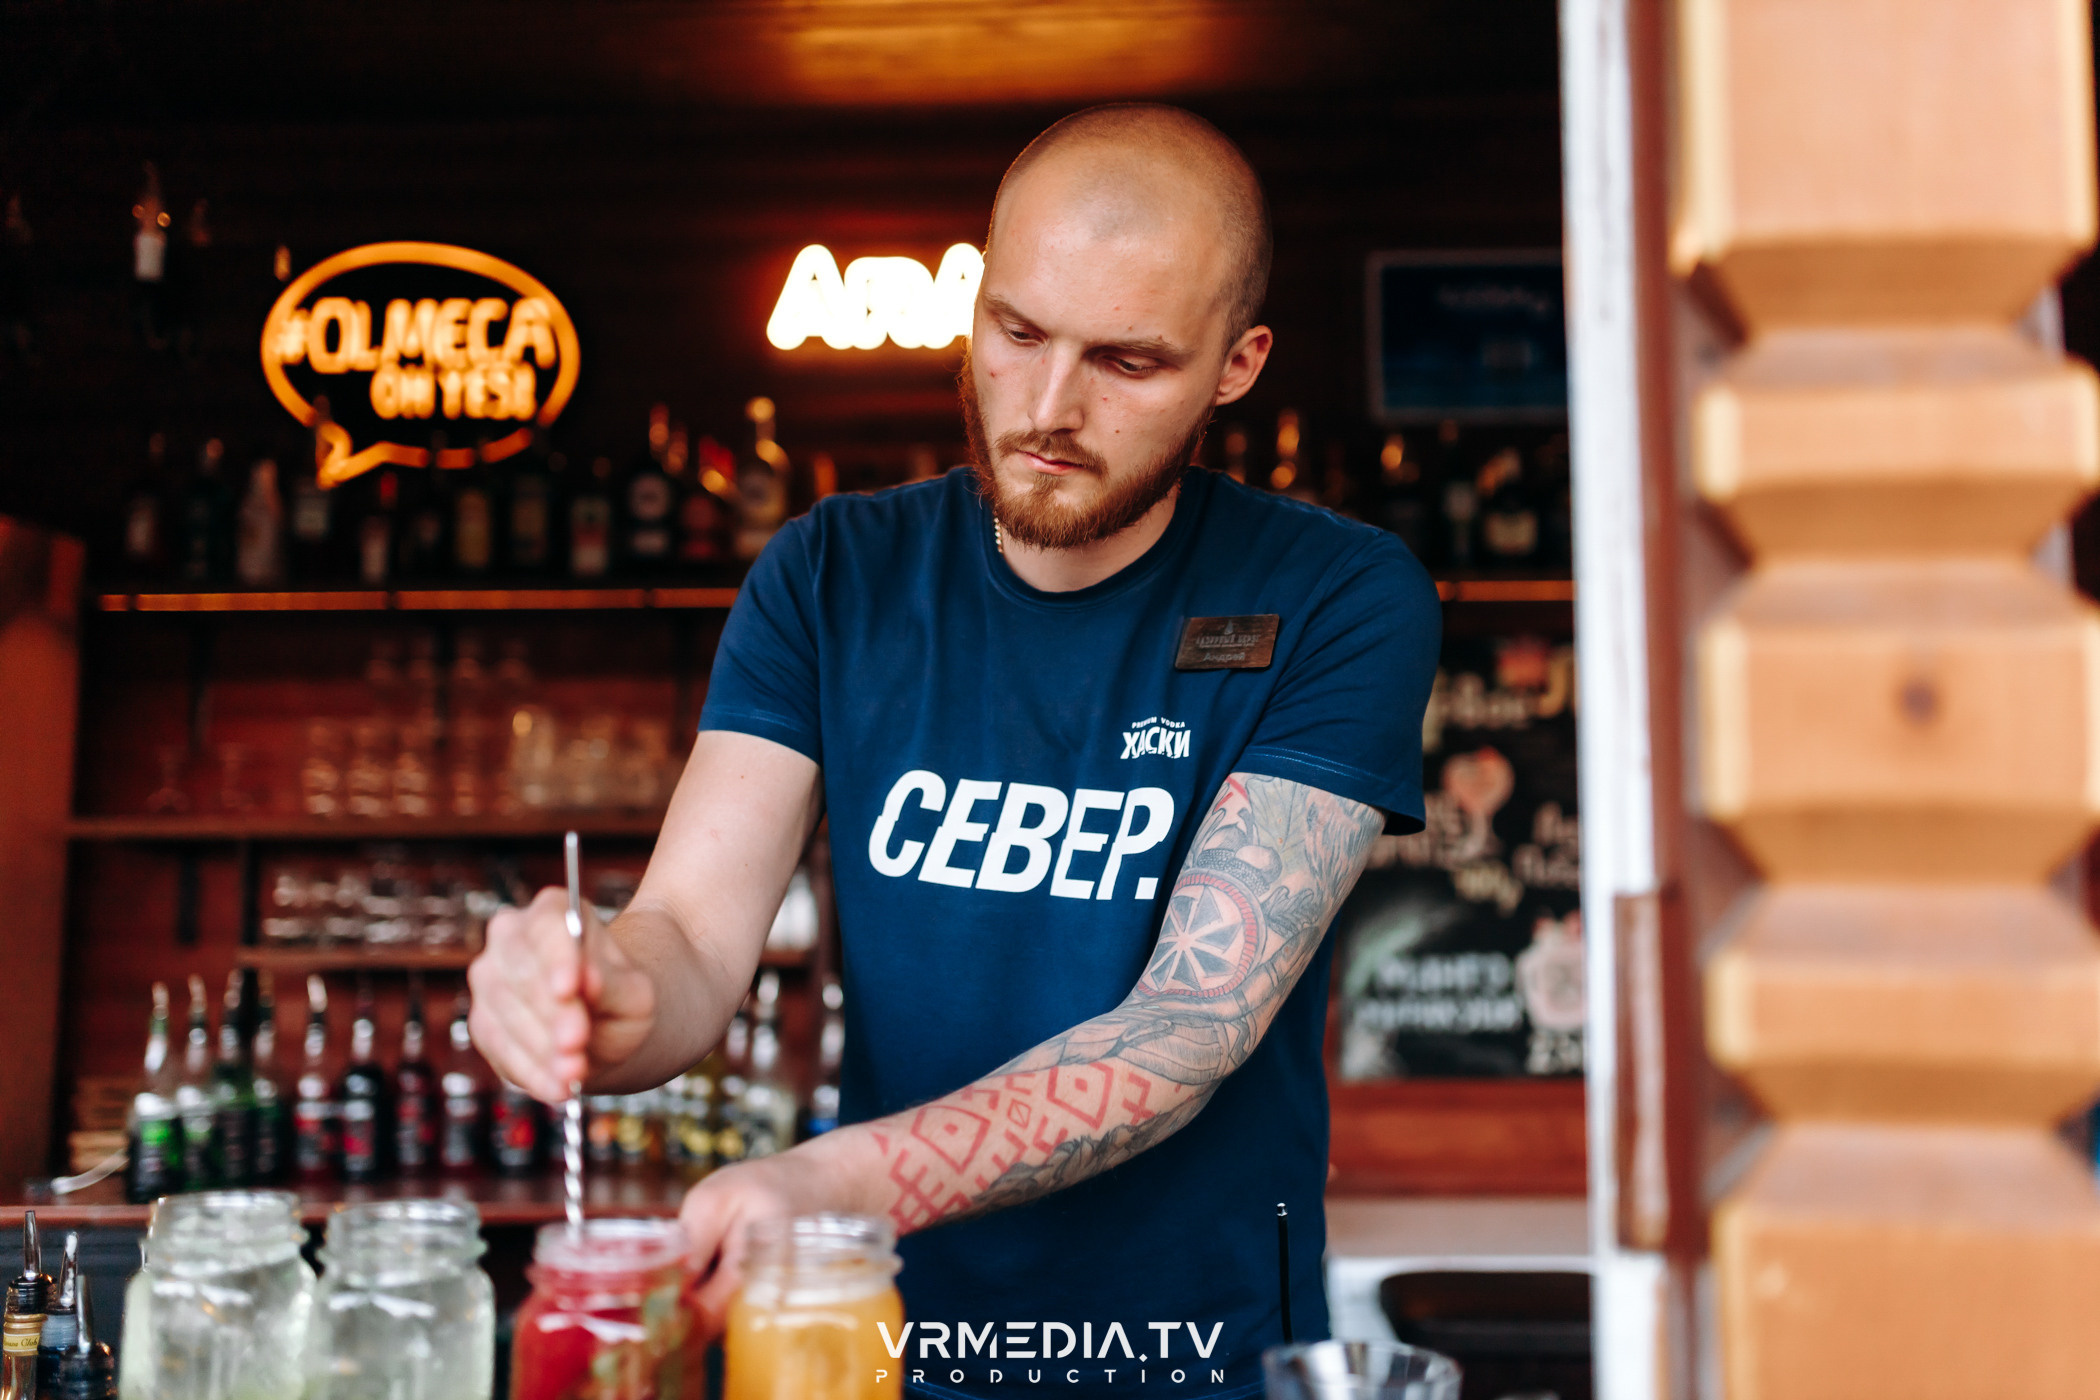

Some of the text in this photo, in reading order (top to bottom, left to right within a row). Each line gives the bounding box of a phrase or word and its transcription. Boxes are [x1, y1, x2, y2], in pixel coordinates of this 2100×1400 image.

[1203, 652, 1246, 663] Андрей
[1131, 716, 1186, 729] PREMIUM VODKA
[1120, 726, 1192, 760] ХАСКИ
[868, 769, 1175, 900] СЕВЕР.
